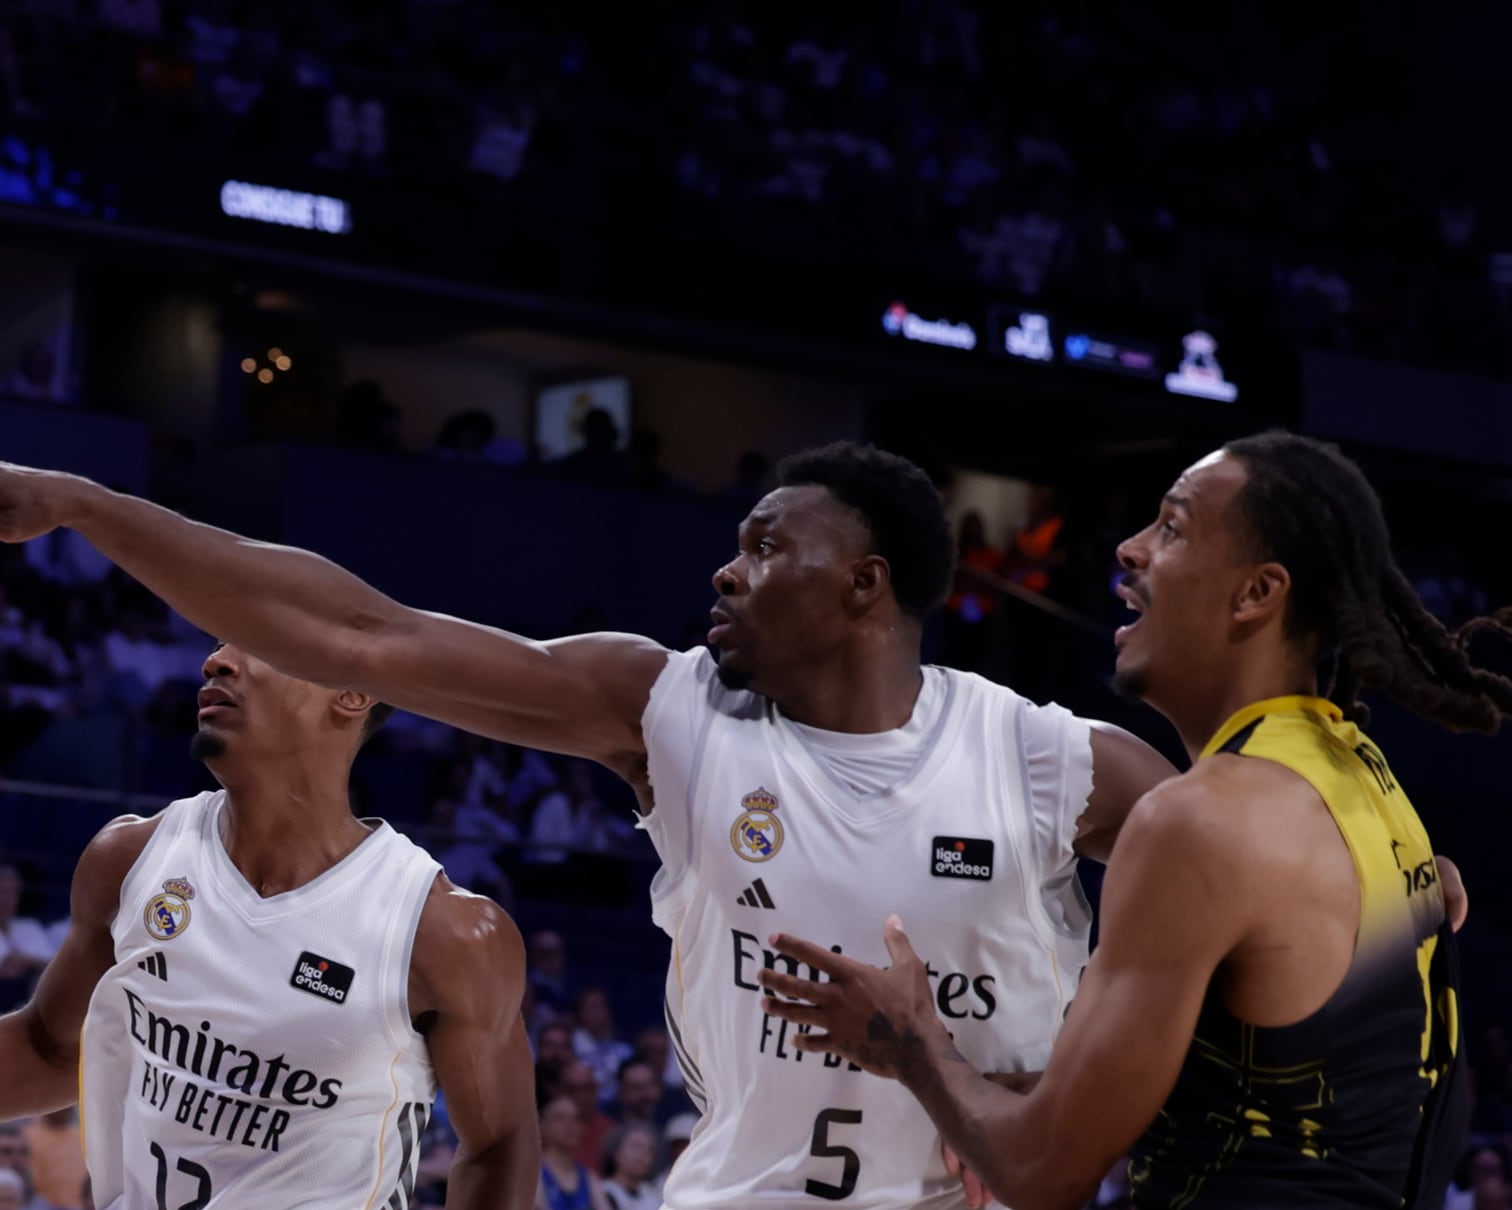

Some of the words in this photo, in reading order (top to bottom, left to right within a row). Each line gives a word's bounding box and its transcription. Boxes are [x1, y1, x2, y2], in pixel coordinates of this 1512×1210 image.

[935, 847, 962, 862] liga
[935, 861, 990, 877] endesa
[295, 975, 345, 1000] endesa
[298, 961, 323, 979] liga
[731, 928, 997, 1020] Emes
[123, 987, 342, 1110] Emirates
[141, 1060, 175, 1112] FLY
[175, 1081, 291, 1152] BETTER
[804, 1107, 864, 1201] 5
